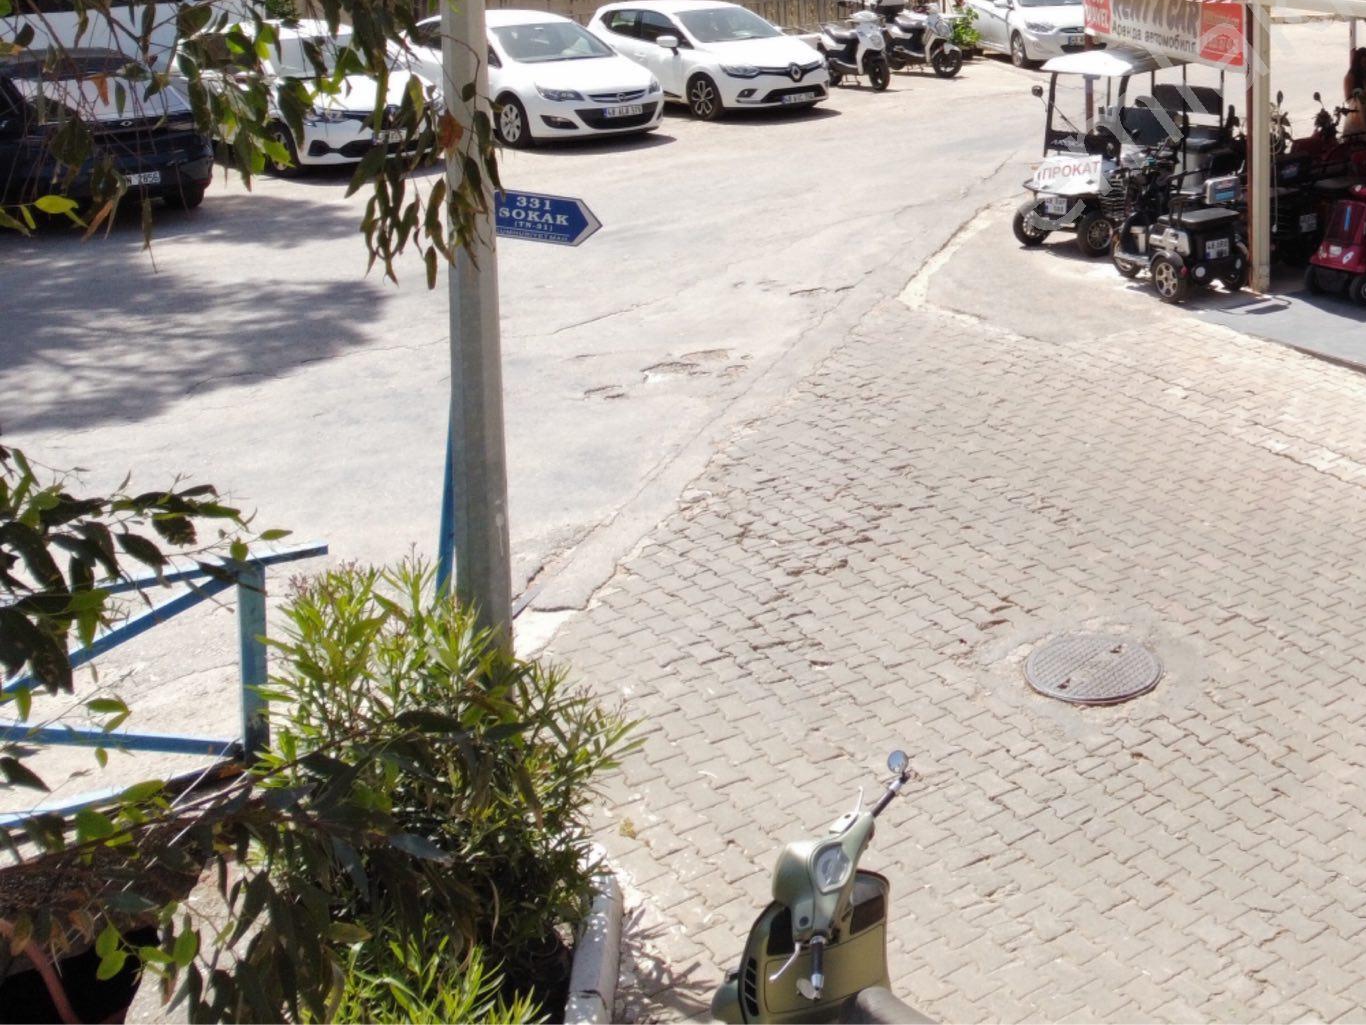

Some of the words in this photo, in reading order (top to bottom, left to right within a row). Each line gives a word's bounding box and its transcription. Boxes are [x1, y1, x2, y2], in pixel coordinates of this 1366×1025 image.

[1042, 160, 1100, 181] ПРОКАТ
[516, 196, 552, 210] 331
[499, 207, 569, 225] SOKAK
